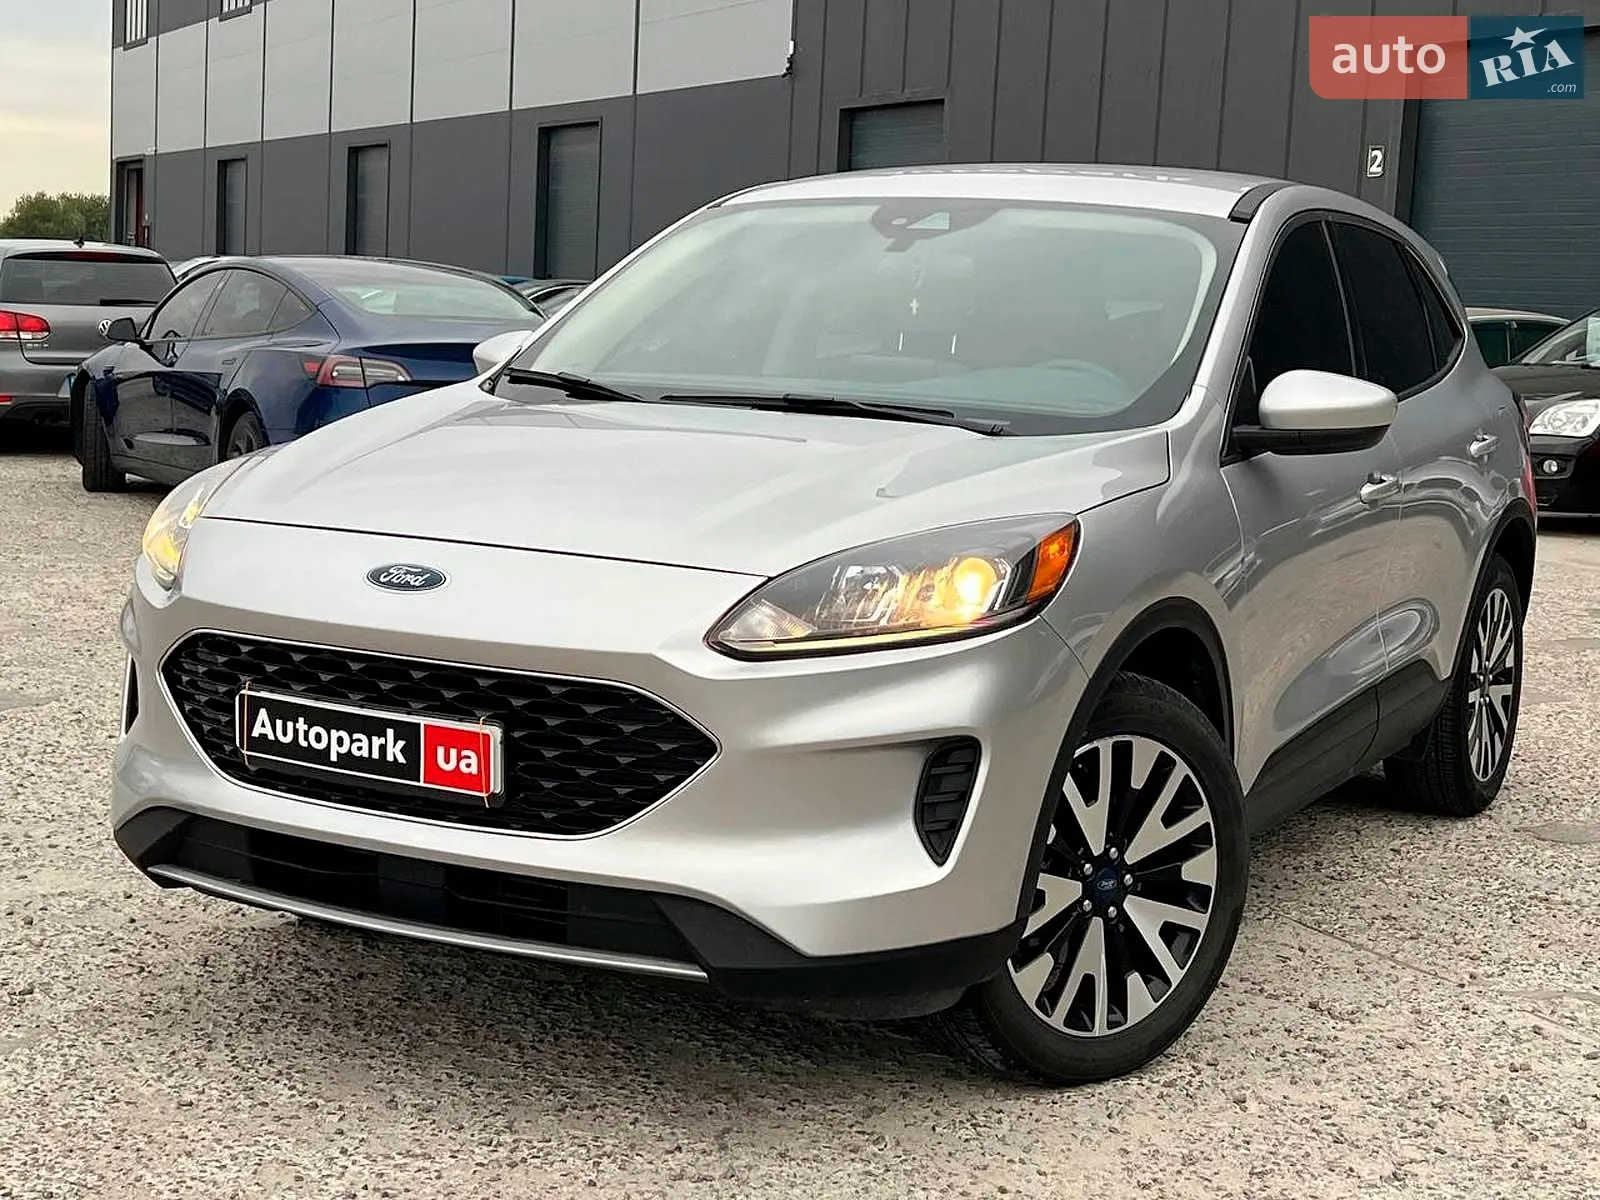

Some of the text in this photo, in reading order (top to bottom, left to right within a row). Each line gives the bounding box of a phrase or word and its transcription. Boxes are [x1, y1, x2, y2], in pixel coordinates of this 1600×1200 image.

[1369, 149, 1383, 173] 2
[379, 565, 431, 587] Ford
[251, 708, 479, 775] Autopark ua
